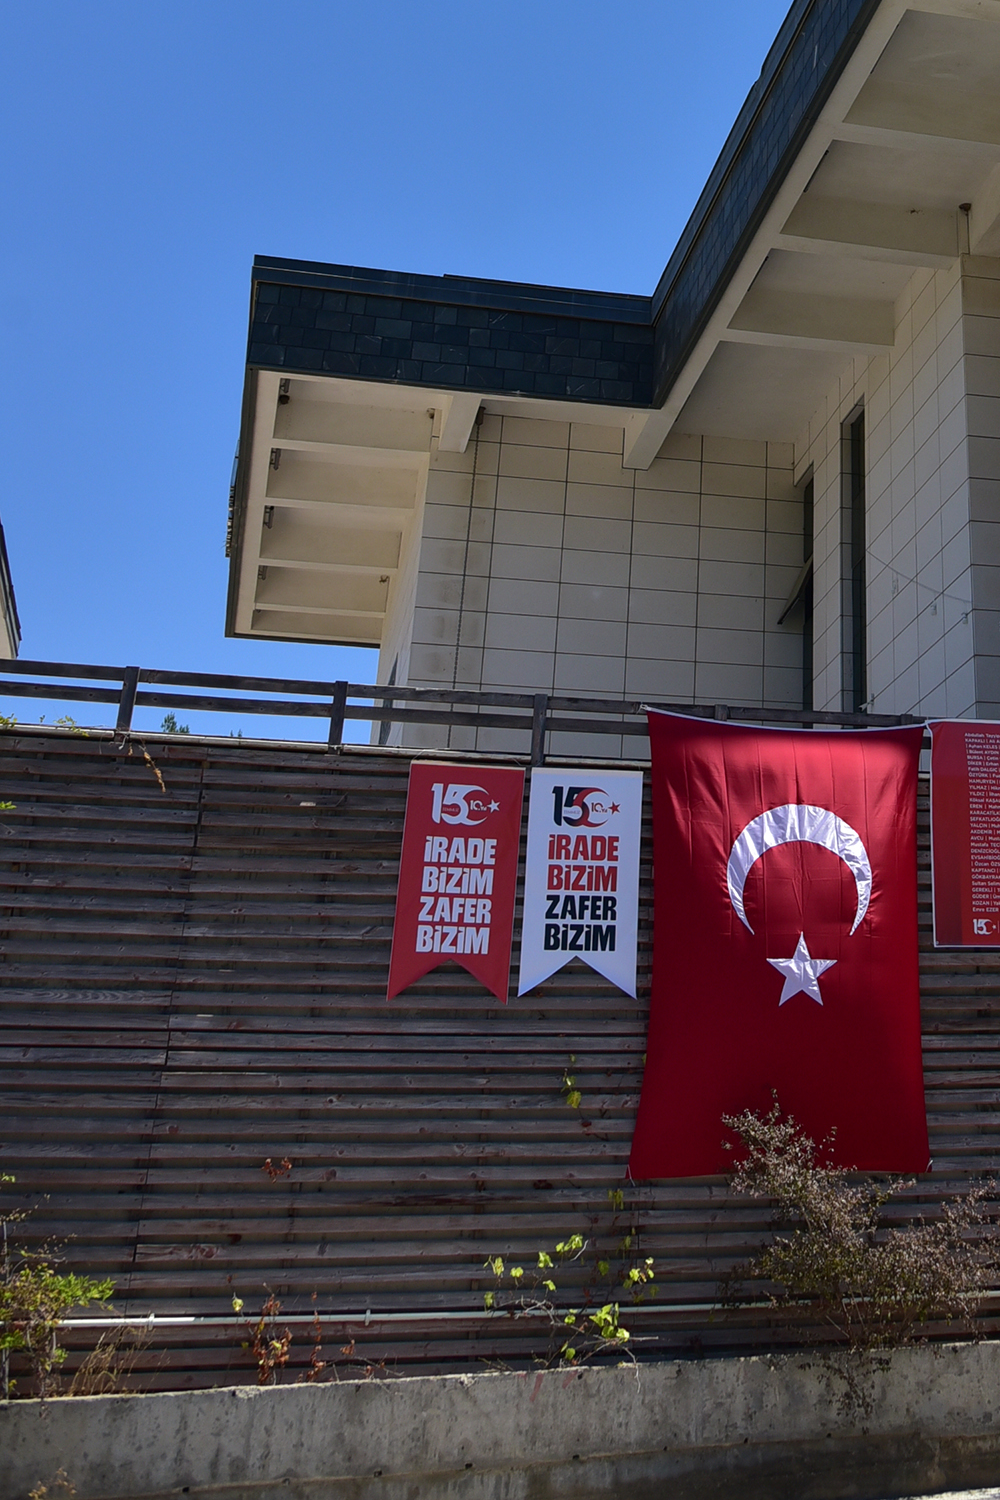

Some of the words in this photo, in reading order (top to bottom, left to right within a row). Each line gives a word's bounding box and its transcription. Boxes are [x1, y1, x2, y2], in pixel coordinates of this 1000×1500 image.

[424, 836, 497, 865] İRADE
[548, 834, 620, 862] İRADE
[421, 866, 494, 895] BİZİM
[547, 864, 617, 892] BİZİM
[418, 896, 492, 924] ZAFER
[544, 894, 617, 921] ZAFER
[415, 925, 490, 955] BİZİM
[543, 923, 616, 952] BİZİM
